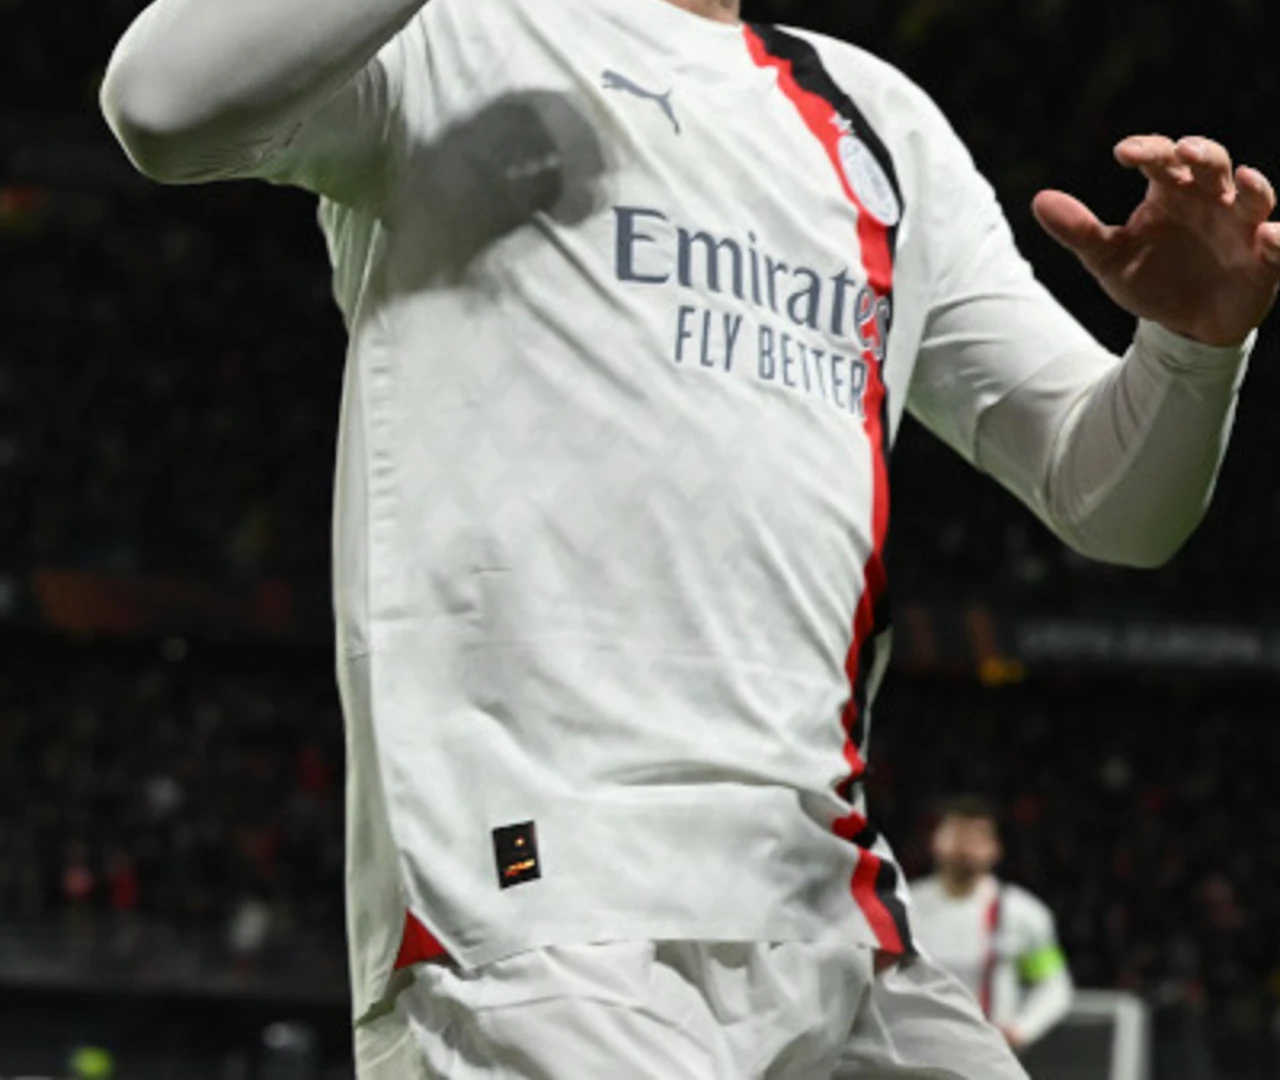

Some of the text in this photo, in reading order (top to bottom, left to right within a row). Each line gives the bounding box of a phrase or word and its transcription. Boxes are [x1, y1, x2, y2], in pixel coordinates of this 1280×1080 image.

[612, 205, 892, 361] Emirates
[675, 305, 867, 418] FLY BETTER
